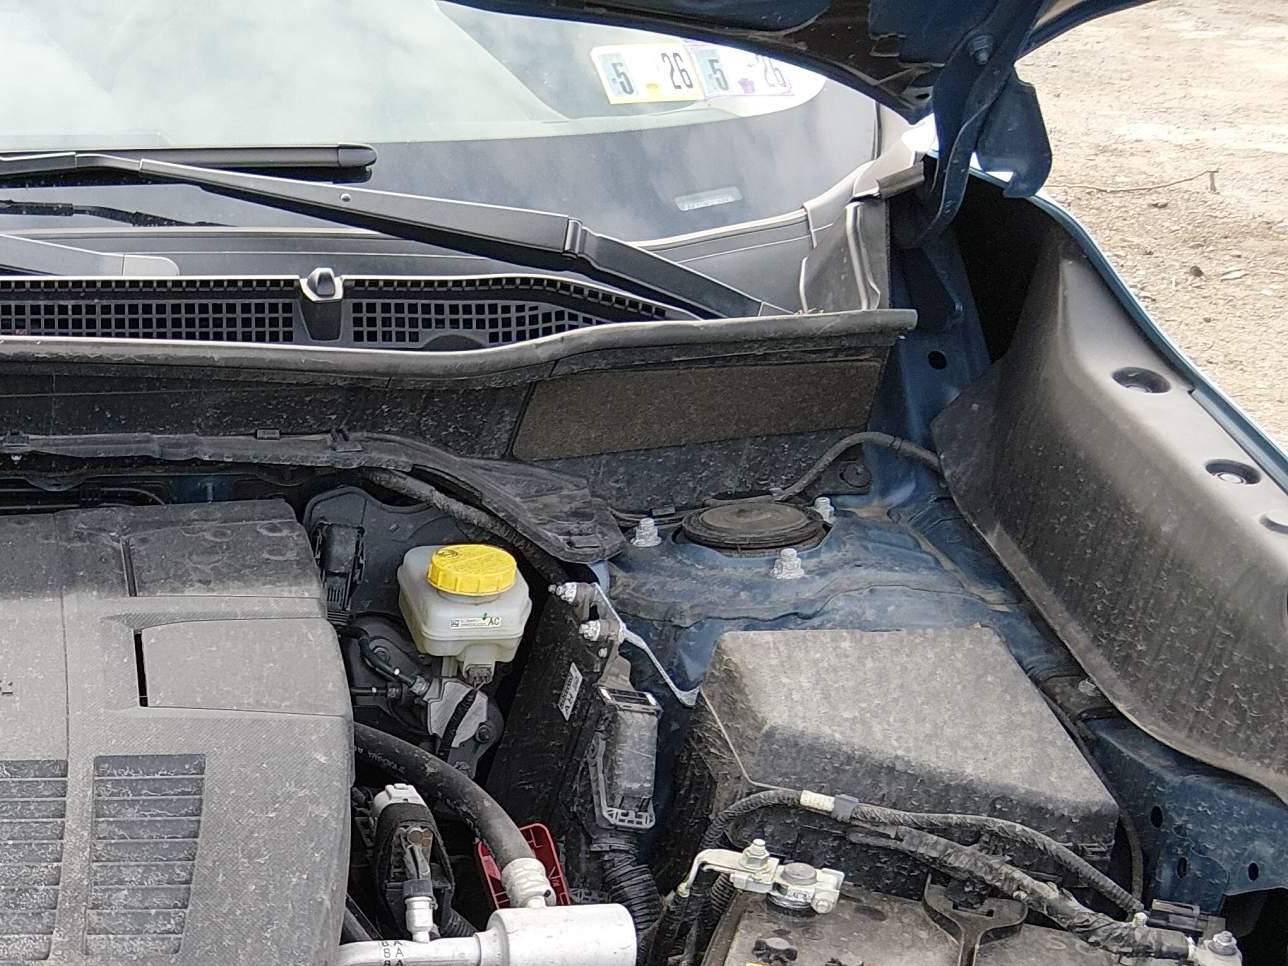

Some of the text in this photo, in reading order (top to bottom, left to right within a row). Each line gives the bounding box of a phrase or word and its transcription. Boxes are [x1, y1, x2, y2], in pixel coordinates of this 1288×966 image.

[613, 53, 693, 95] 5 26
[709, 59, 729, 91] 5
